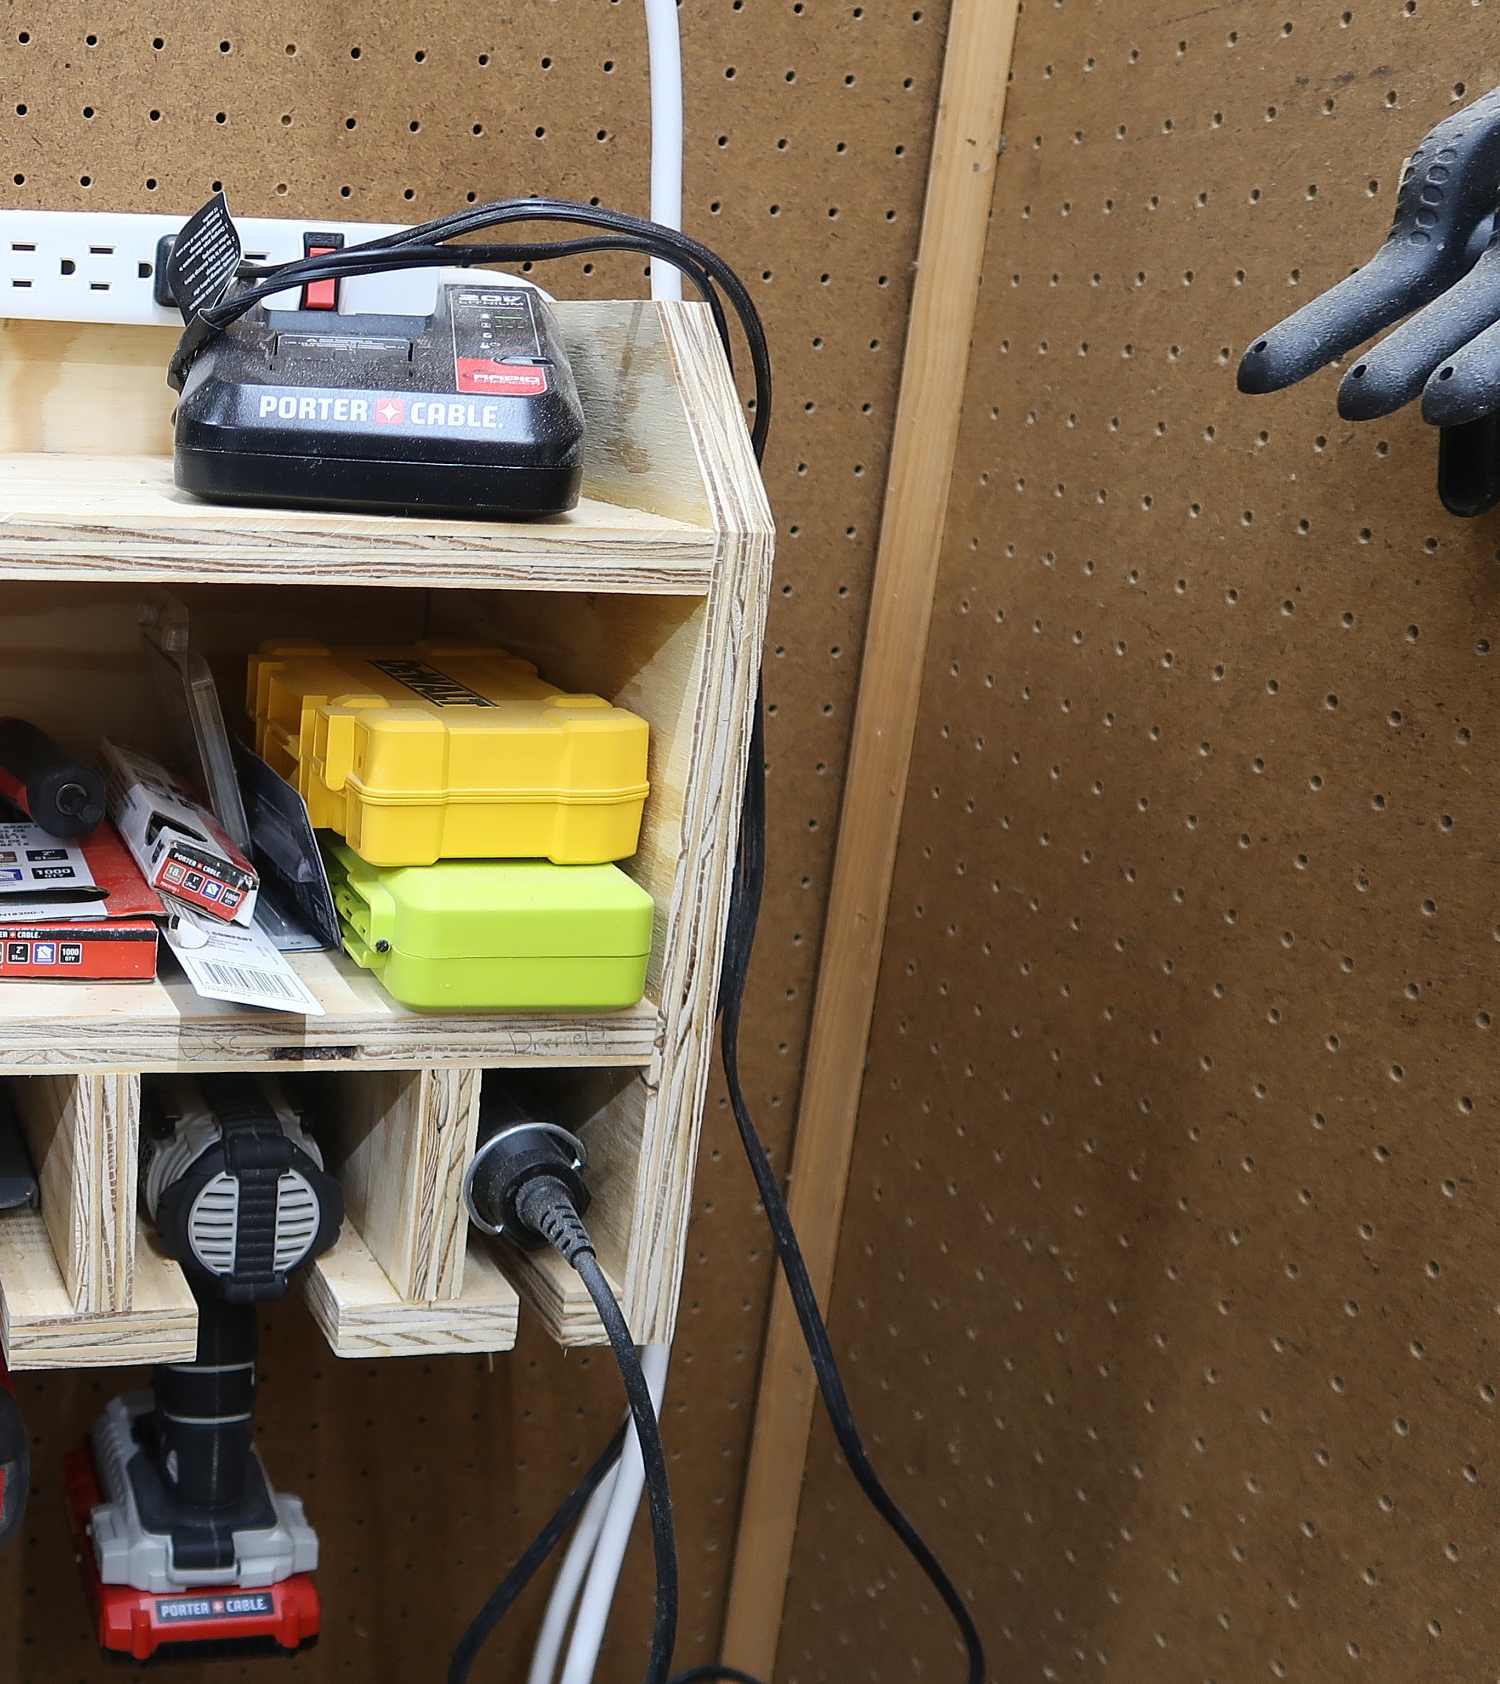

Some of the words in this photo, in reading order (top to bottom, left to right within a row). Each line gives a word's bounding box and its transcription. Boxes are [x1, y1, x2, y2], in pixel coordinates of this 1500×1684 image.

[259, 395, 368, 422] PORTER
[174, 852, 197, 867] PORTER
[225, 891, 239, 902] 1000
[62, 948, 80, 956] 1000
[161, 1602, 209, 1617] PORTER
